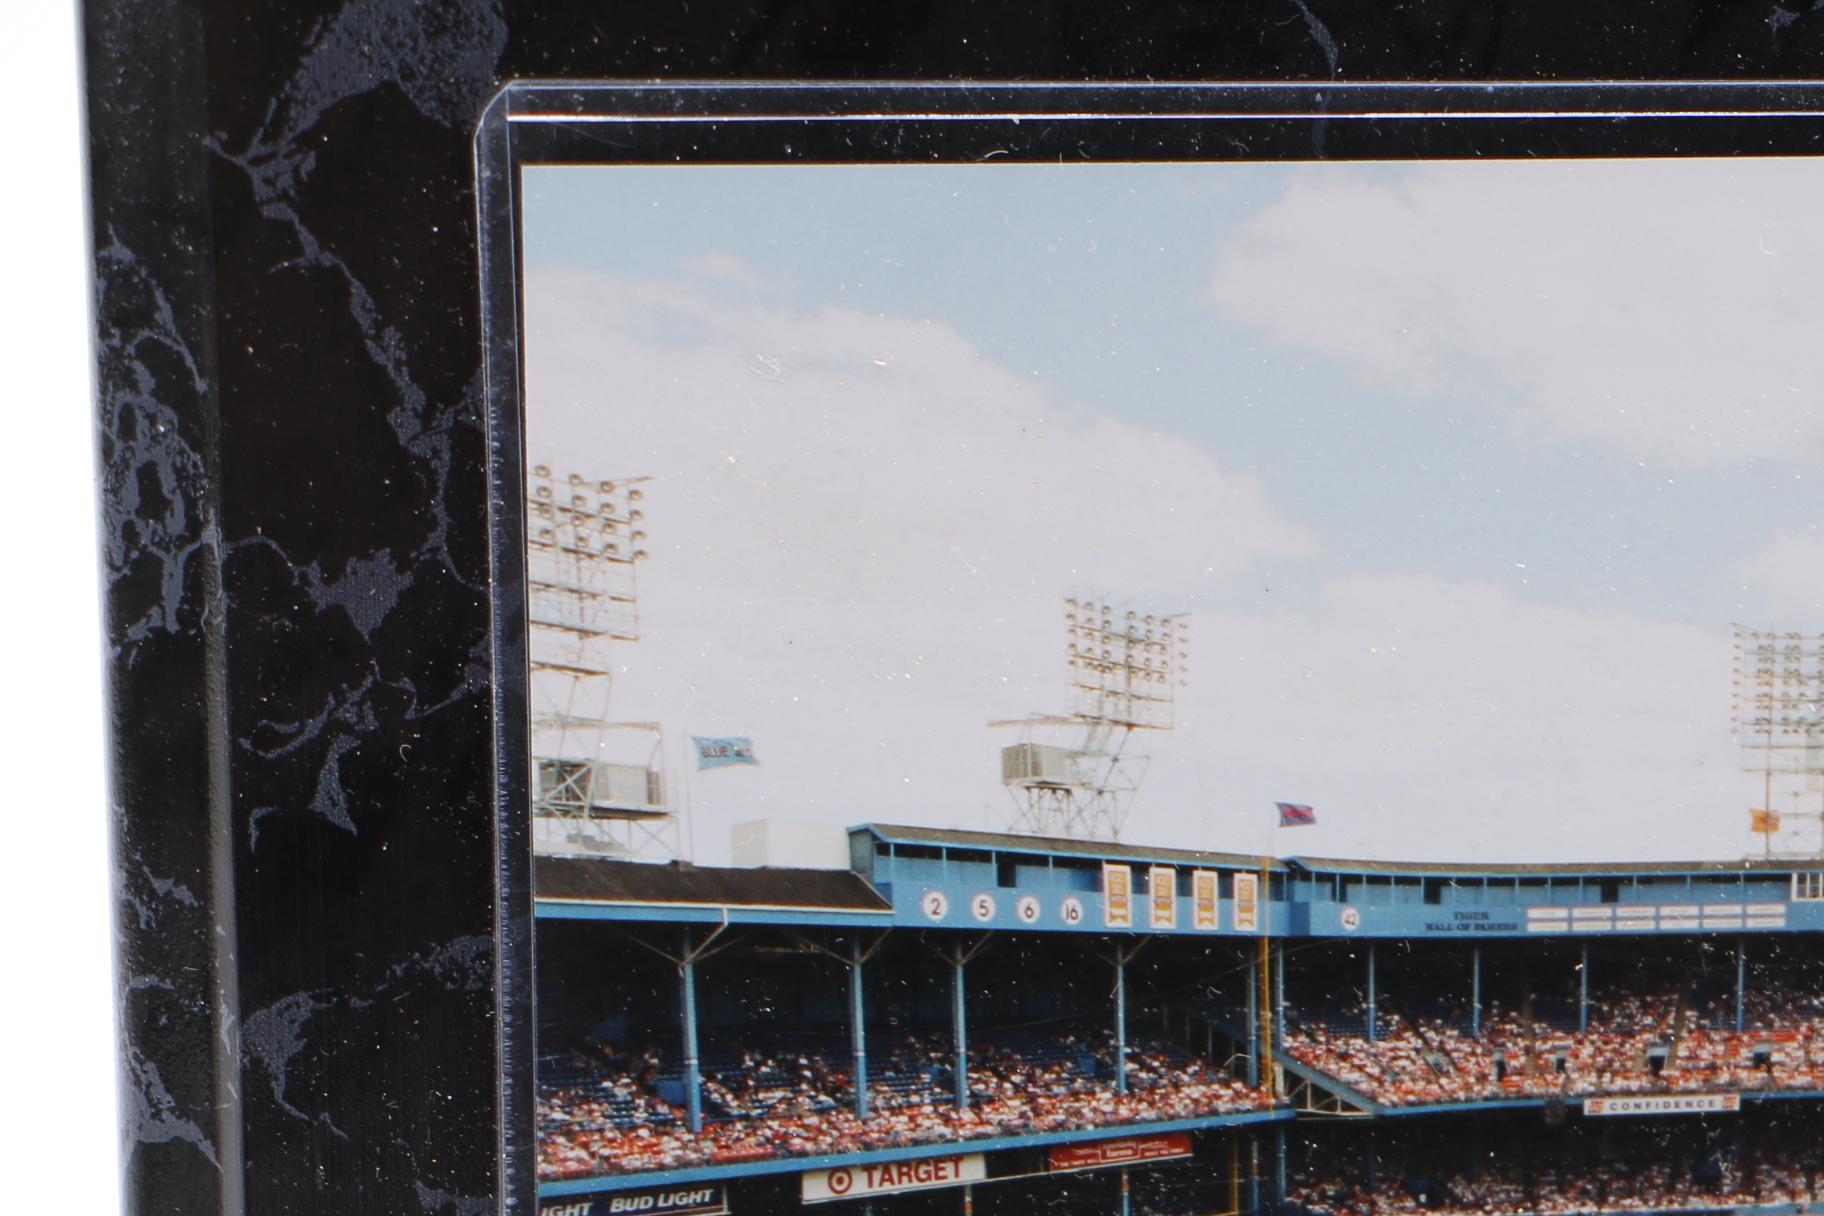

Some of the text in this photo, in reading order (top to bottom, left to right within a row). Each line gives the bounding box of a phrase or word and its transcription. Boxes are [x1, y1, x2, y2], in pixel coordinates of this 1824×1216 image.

[931, 898, 940, 915] 2
[979, 899, 989, 917] 5
[1024, 902, 1034, 919] 6
[1065, 903, 1079, 920] 16
[1454, 911, 1490, 921] TIGER
[1425, 922, 1453, 931] HALL
[1456, 922, 1471, 931] OF
[1609, 1100, 1715, 1111] CONFIDENCE
[862, 1156, 964, 1188] TARGET
[610, 1196, 654, 1213] BUD
[657, 1189, 714, 1207] LIGHT
